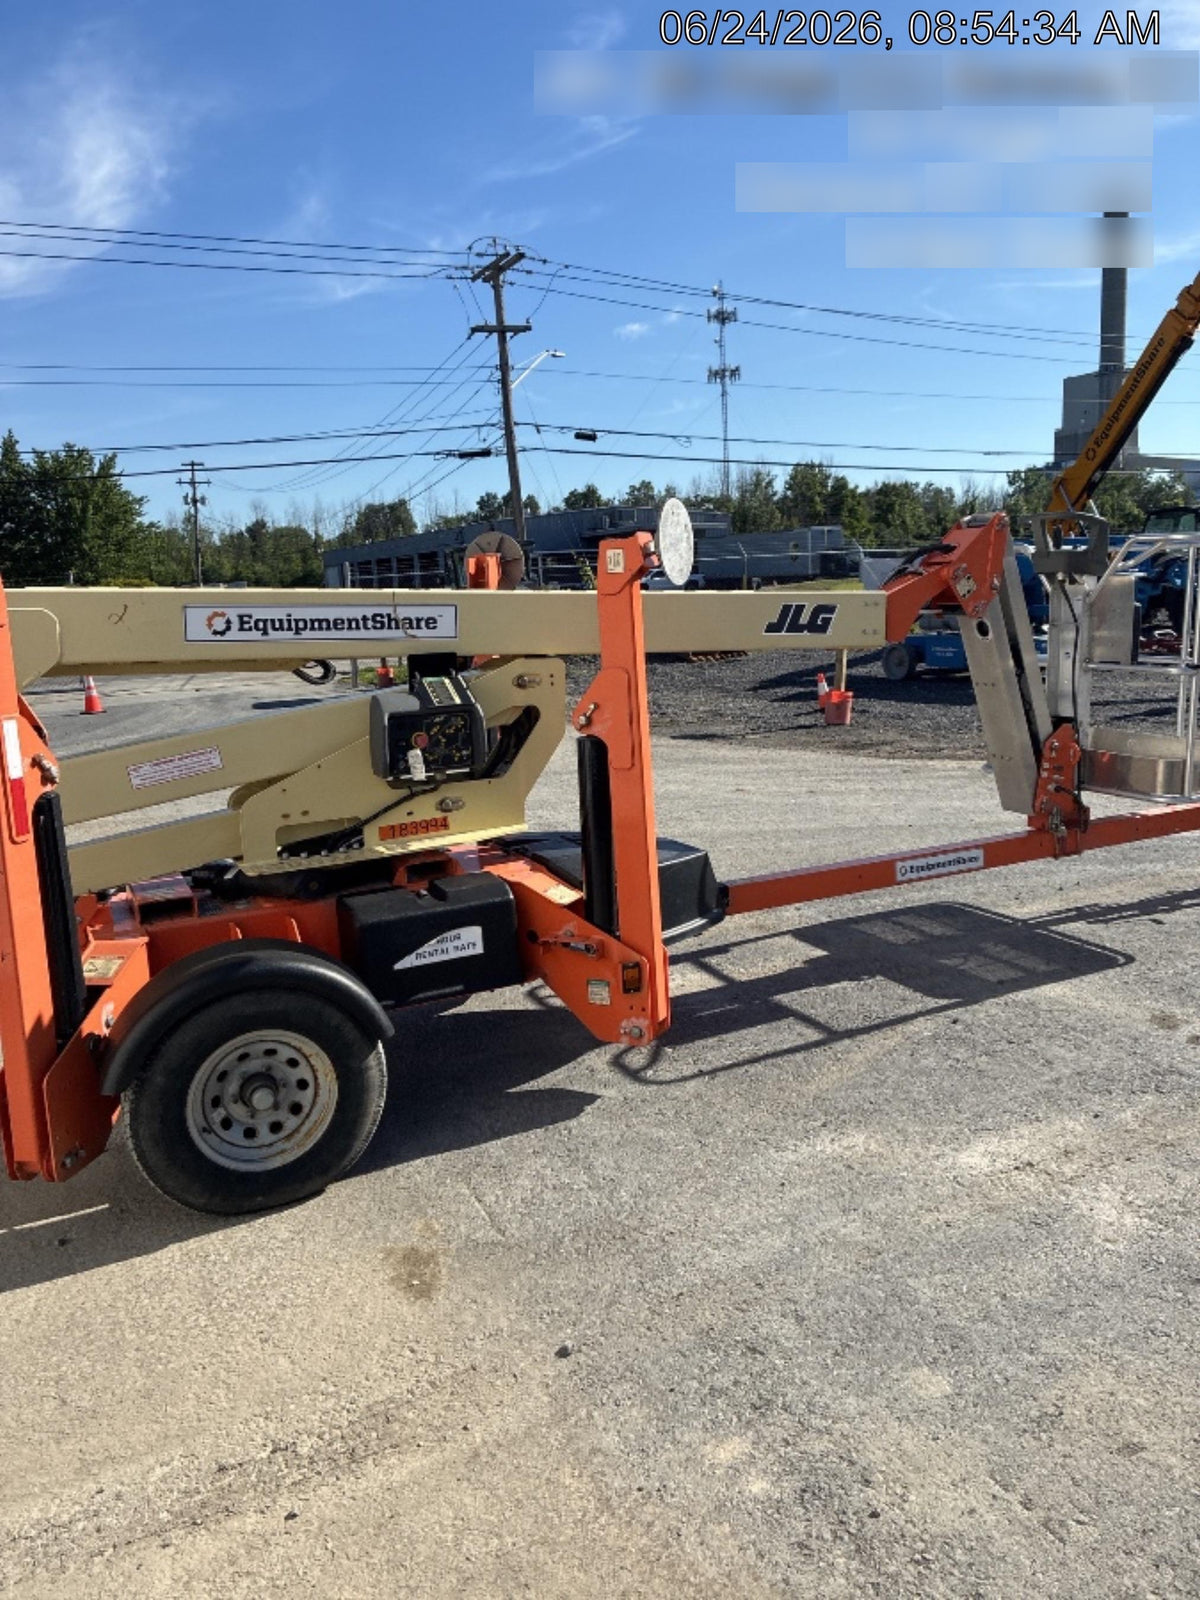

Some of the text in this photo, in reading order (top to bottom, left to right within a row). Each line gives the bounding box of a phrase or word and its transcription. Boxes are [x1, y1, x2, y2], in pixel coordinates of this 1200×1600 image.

[1094, 335, 1165, 448] EquipmentShare
[237, 612, 438, 636] EquipmentShare
[762, 602, 840, 635] JLG
[389, 816, 449, 839] 183994
